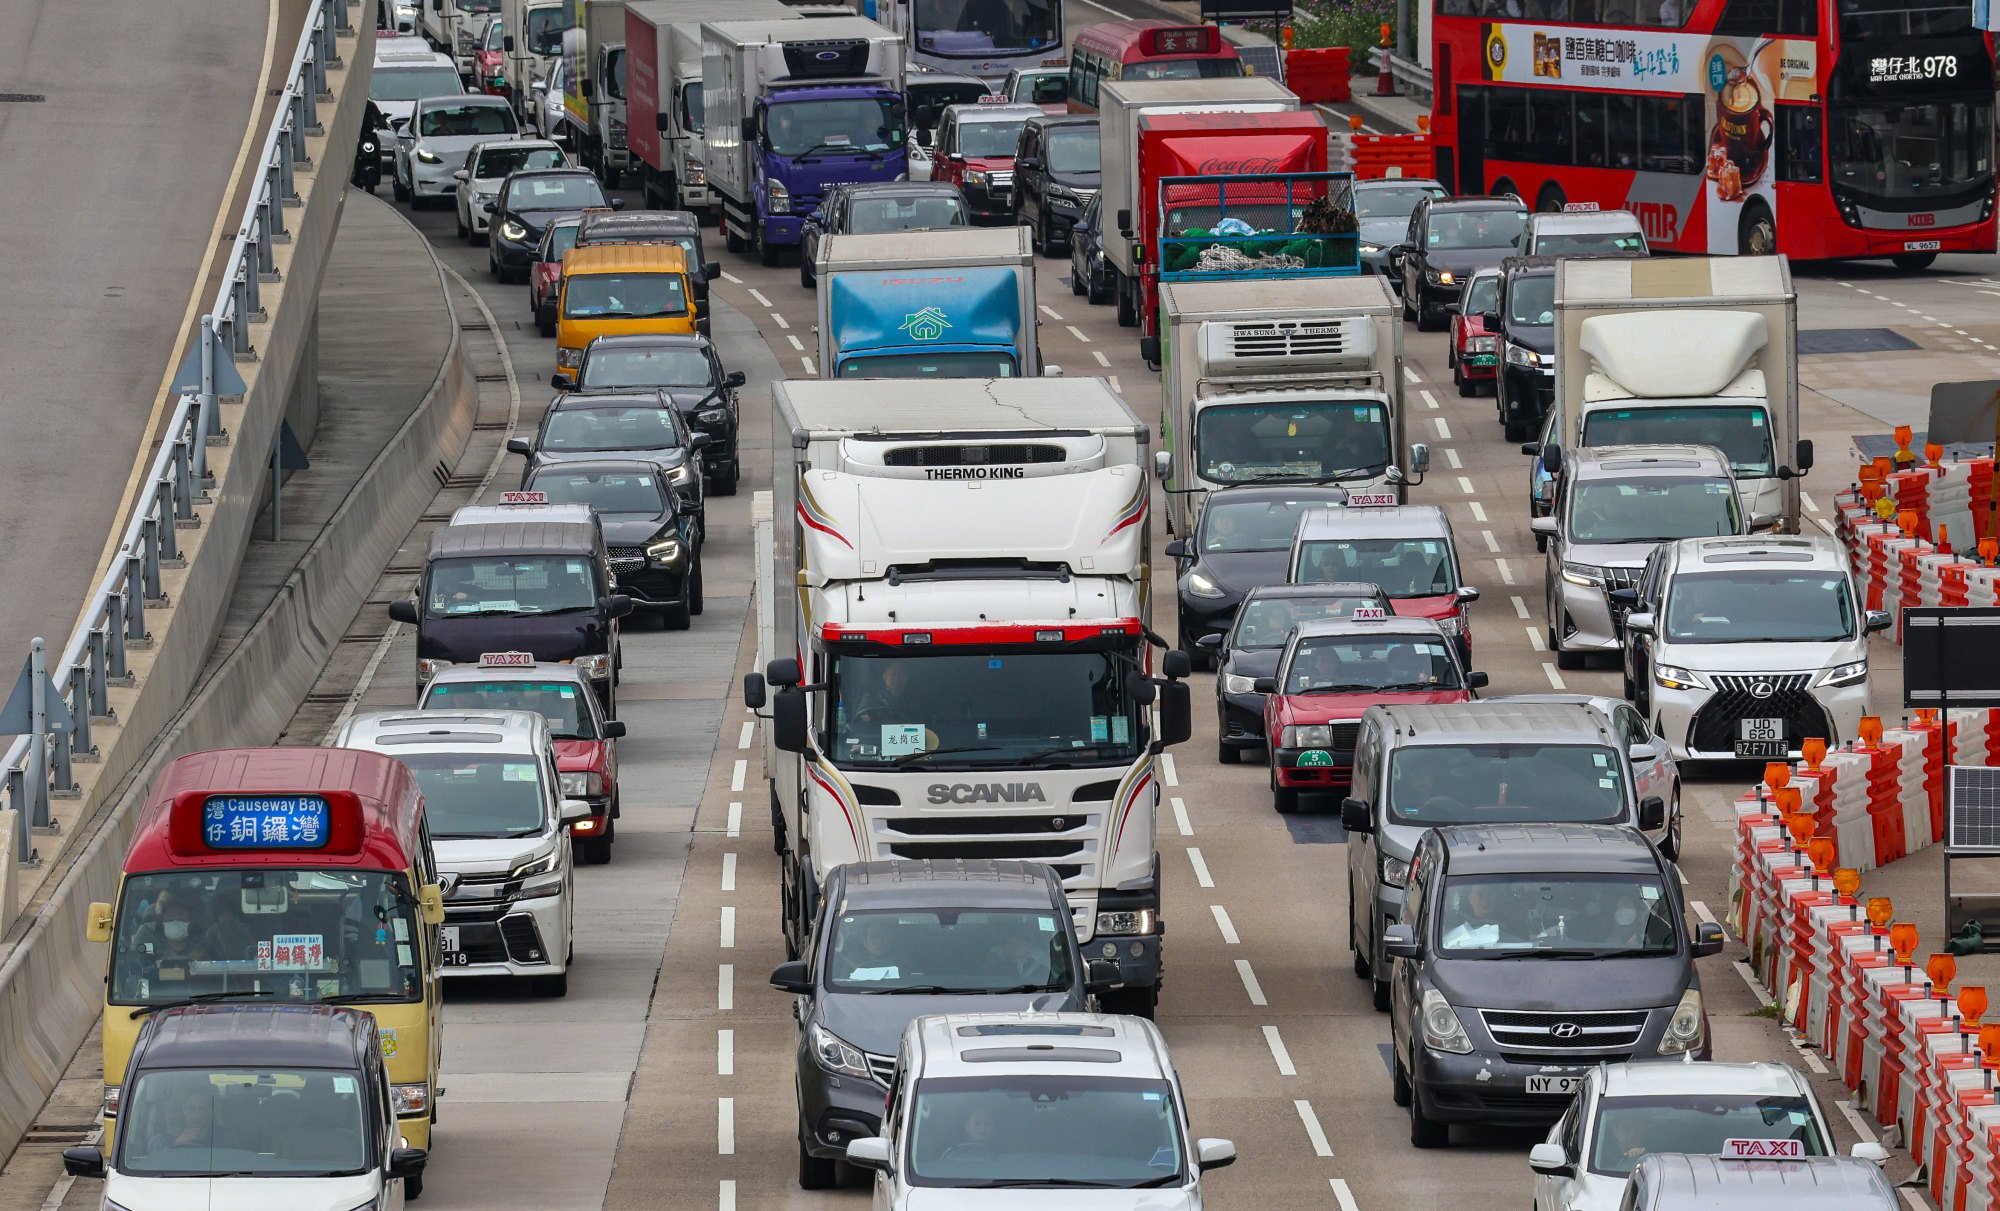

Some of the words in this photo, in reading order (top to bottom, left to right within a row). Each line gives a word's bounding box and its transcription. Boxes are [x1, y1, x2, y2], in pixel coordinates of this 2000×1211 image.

[1163, 38, 1198, 49] 荃灣
[1787, 59, 1810, 70] ORIGINAL
[1871, 56, 1920, 75] 灣仔北
[1923, 55, 1957, 78] 978
[1567, 203, 1596, 211] TAXI
[1907, 213, 1936, 227] KMB
[882, 277, 964, 285] ISUZU
[925, 468, 986, 480] THERMO
[989, 467, 1023, 479] KING
[504, 492, 544, 502] TAXI
[1352, 495, 1393, 505] TAXI
[1356, 609, 1383, 618] TAXI
[484, 654, 530, 665] TAXI
[1753, 719, 1771, 729] UD
[888, 734, 919, 745] 龙岗区
[1749, 729, 1775, 739] 620
[1311, 754, 1319, 762] 5
[927, 782, 1046, 805] SCANIA
[228, 798, 296, 815] Causeway
[299, 797, 323, 815] Bay
[206, 800, 227, 842] 灣仔
[229, 814, 320, 843] 銅鑼灣
[258, 947, 271, 959] 23
[275, 943, 322, 967] 銅鑼灣
[259, 959, 270, 970] 元
[1530, 1078, 1552, 1092] NY
[1731, 1140, 1798, 1157] TAXI
